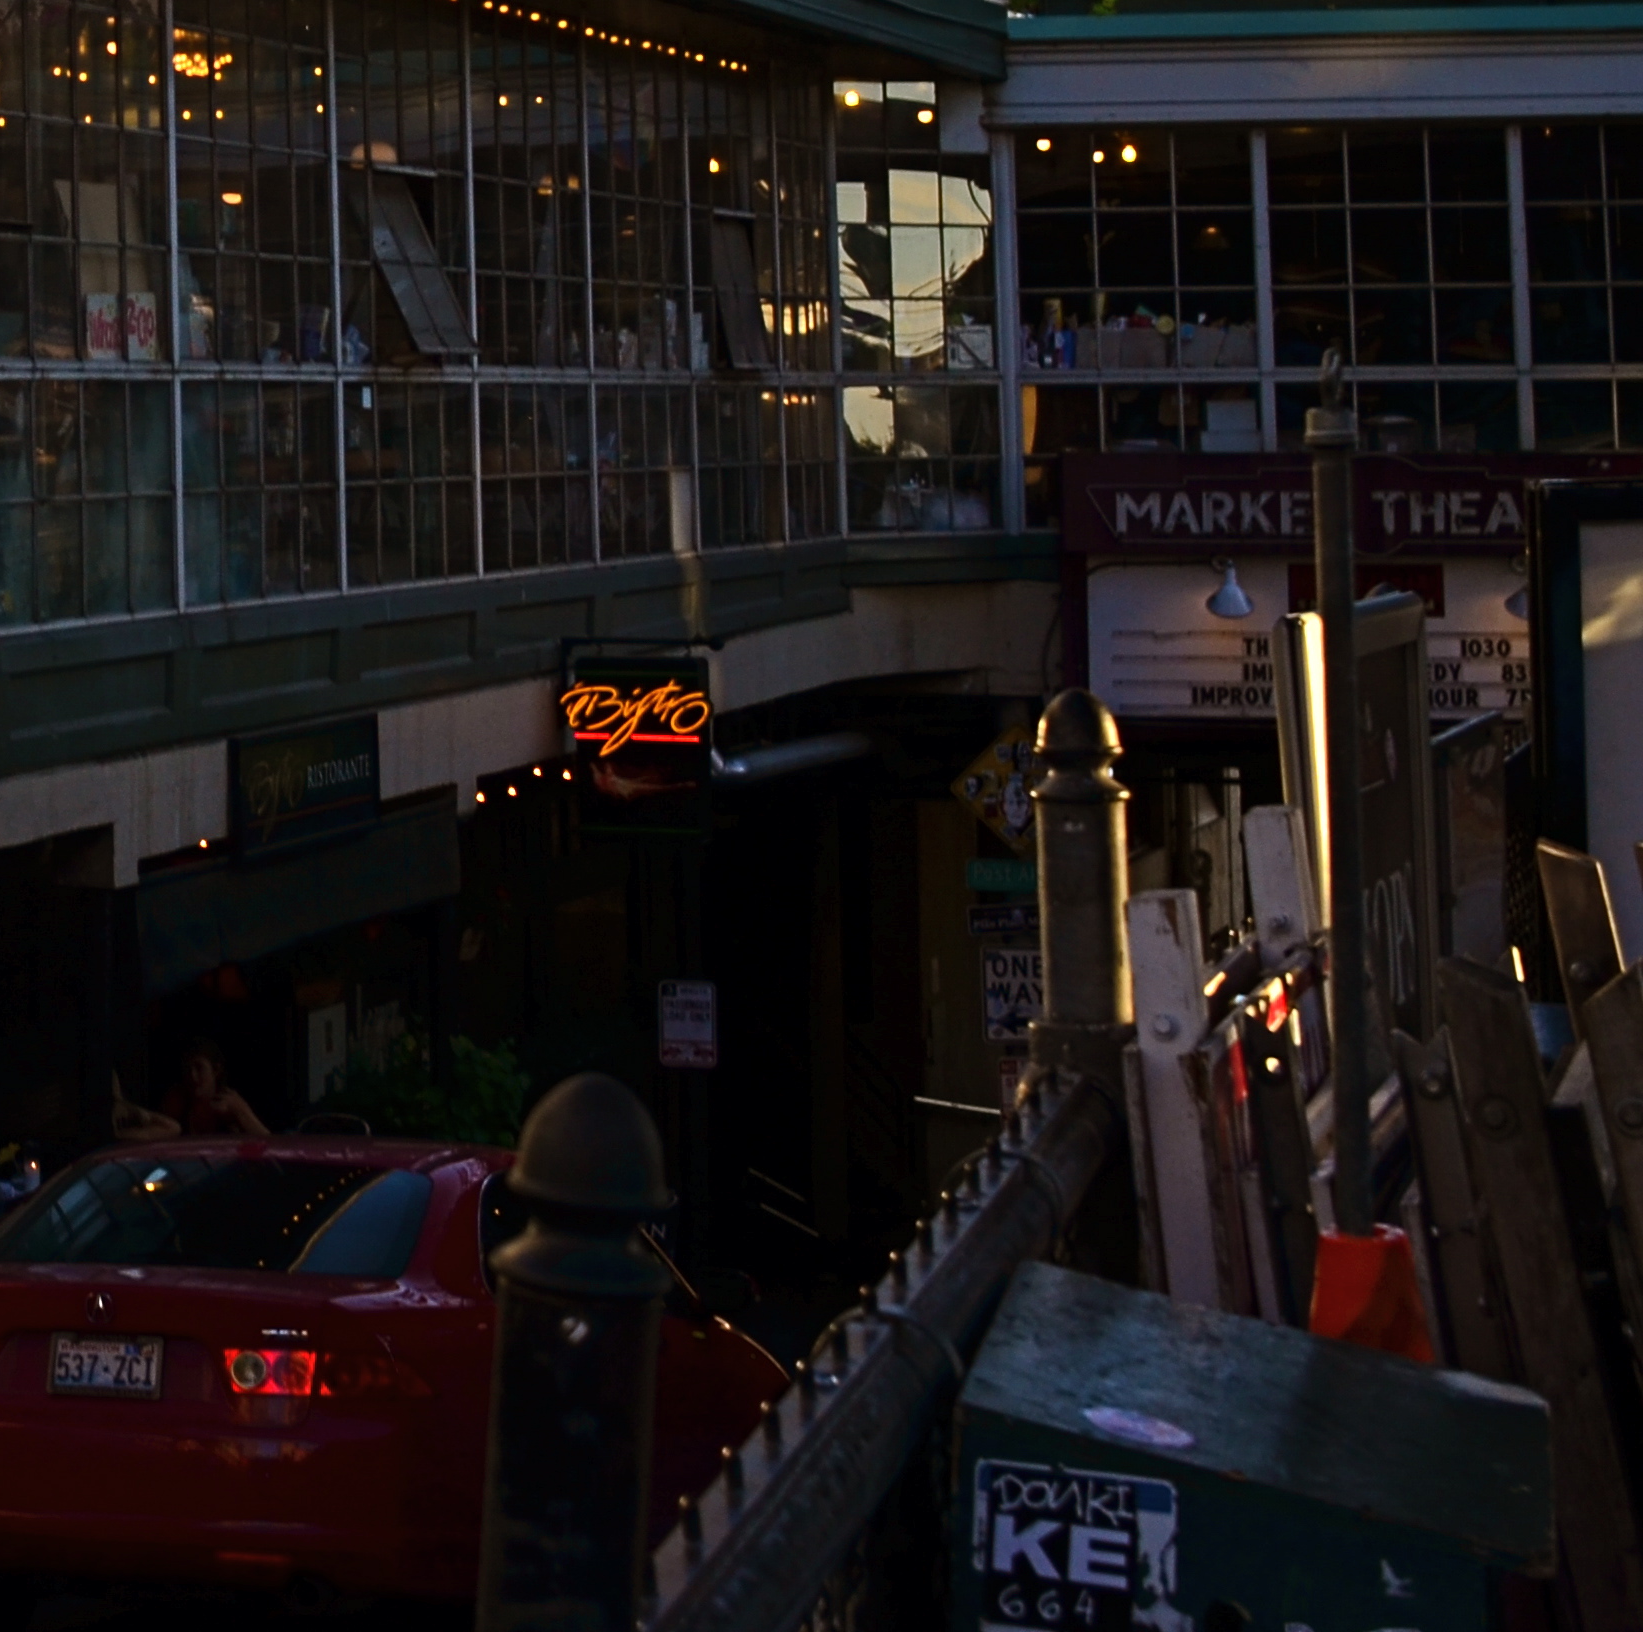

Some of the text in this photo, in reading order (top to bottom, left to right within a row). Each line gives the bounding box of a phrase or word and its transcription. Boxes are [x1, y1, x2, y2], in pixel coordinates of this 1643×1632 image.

[1115, 488, 1526, 538] MARKE THEA
[1243, 638, 1510, 658] TH 1030
[1244, 663, 1273, 681] IM
[1502, 663, 1527, 682] 83
[1192, 686, 1273, 706] IMPROV
[307, 752, 372, 790] RISTORANTE
[992, 955, 1042, 978] ONE
[992, 982, 1044, 1005] WAY
[991, 1512, 1133, 1594] KE
